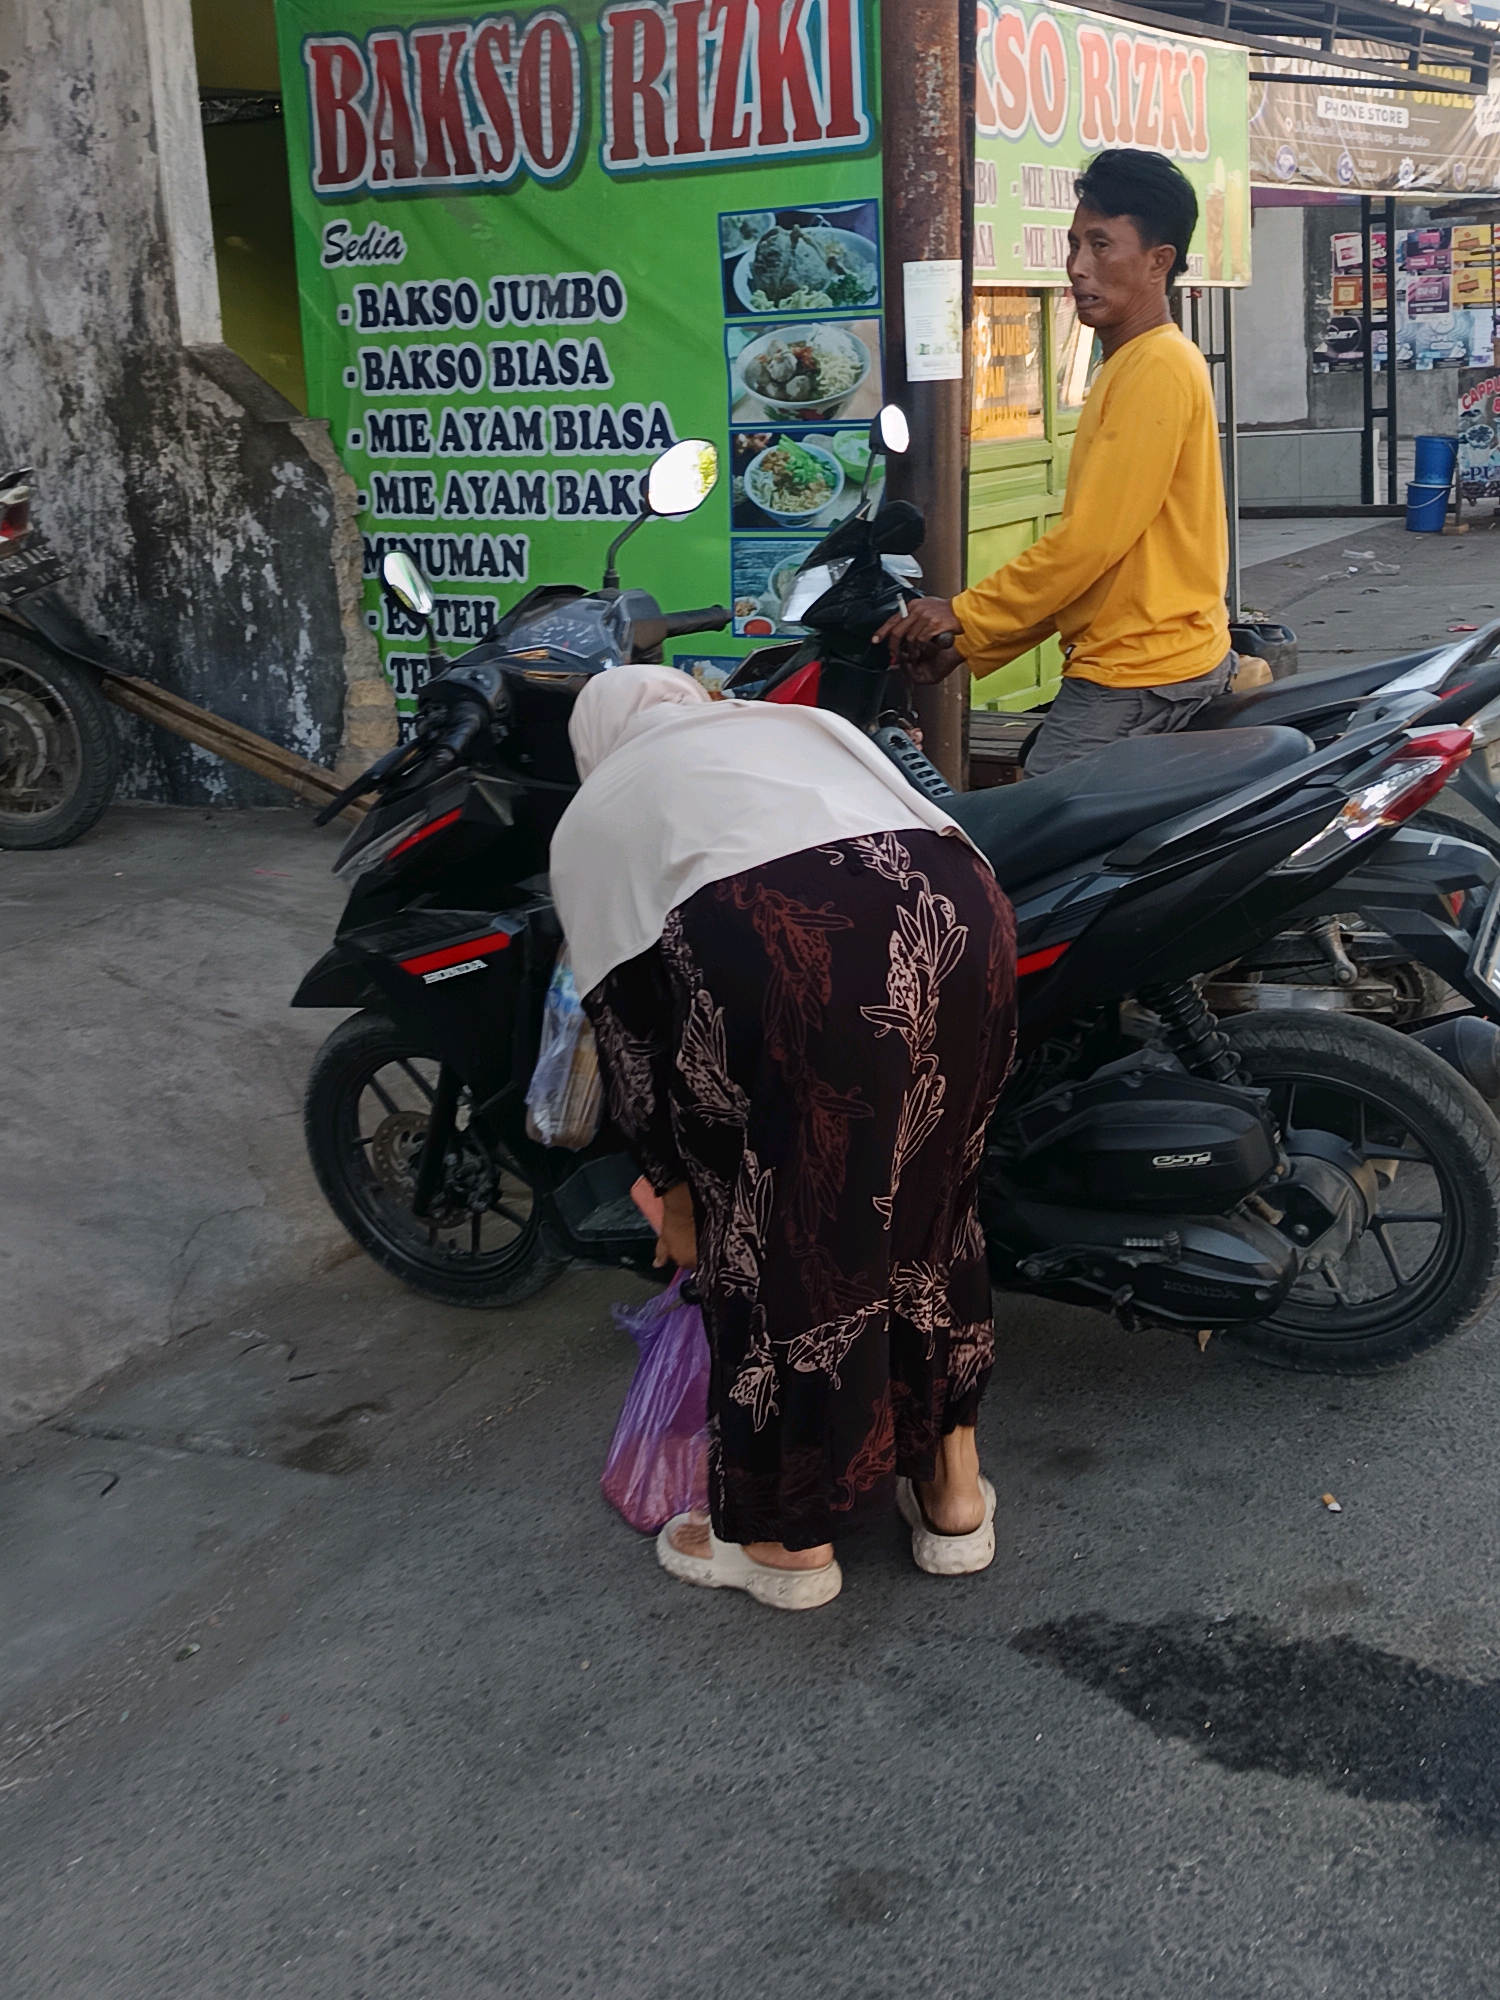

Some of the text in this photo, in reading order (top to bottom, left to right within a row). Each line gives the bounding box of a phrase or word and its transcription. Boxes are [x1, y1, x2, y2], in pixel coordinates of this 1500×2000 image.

[310, 0, 861, 186] BAKSO RIZKI
[1078, 30, 1208, 153] RIZKI
[1324, 102, 1403, 124] PHONE STORE
[1021, 165, 1046, 209] MIE
[324, 222, 405, 266] Sedia
[1023, 226, 1047, 268] MIE
[1051, 229, 1070, 269] AY
[357, 275, 623, 328] BAKSO JUMBO
[992, 325, 1030, 357] JUMBO
[362, 342, 610, 391] BAKSO BIASA
[367, 407, 674, 454] MIE AYAM BIASA
[373, 475, 436, 515] MIE
[443, 474, 546, 515] AYAM
[363, 536, 527, 578] MNUMAN
[434, 600, 496, 638] TEH
[390, 656, 431, 694] TE
